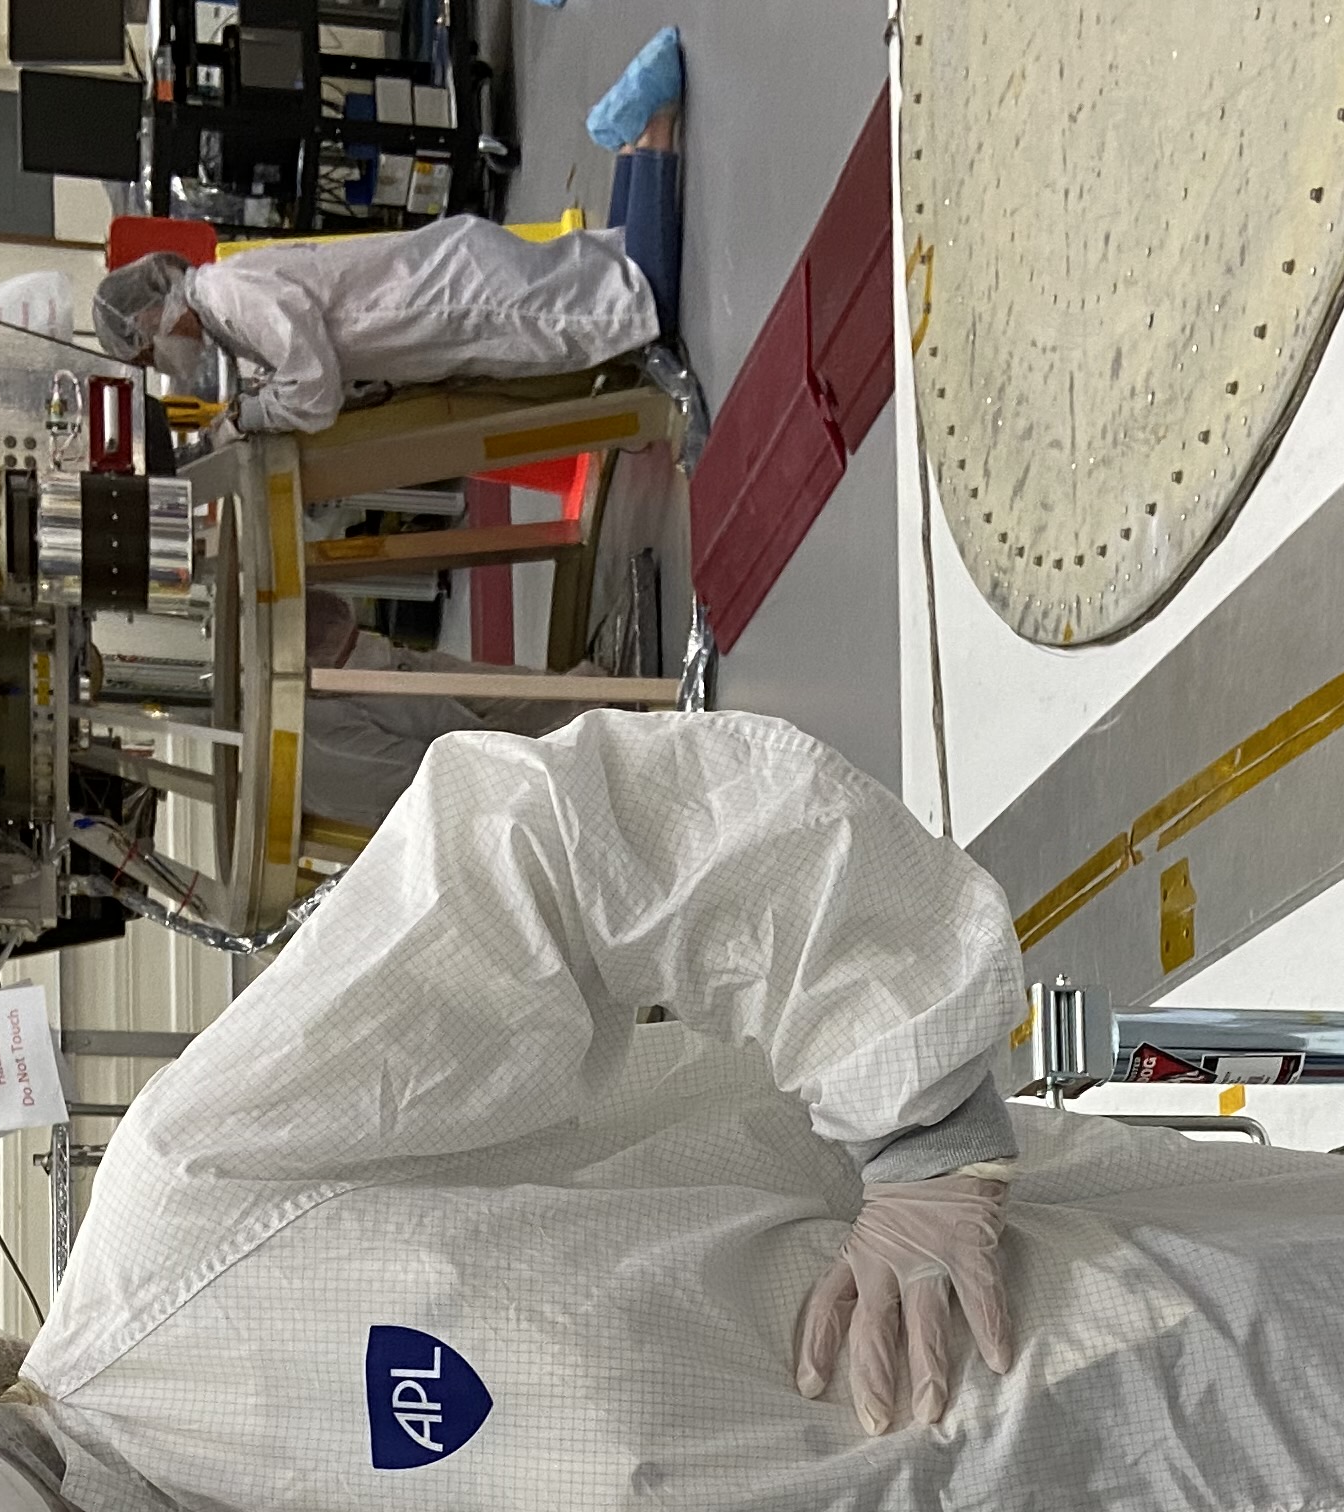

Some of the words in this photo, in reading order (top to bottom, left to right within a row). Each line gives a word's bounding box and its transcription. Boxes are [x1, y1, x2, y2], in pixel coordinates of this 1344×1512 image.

[7, 1009, 23, 1053] Touch
[15, 1057, 30, 1083] Not
[22, 1087, 34, 1106] Do
[390, 1347, 444, 1452] APL
